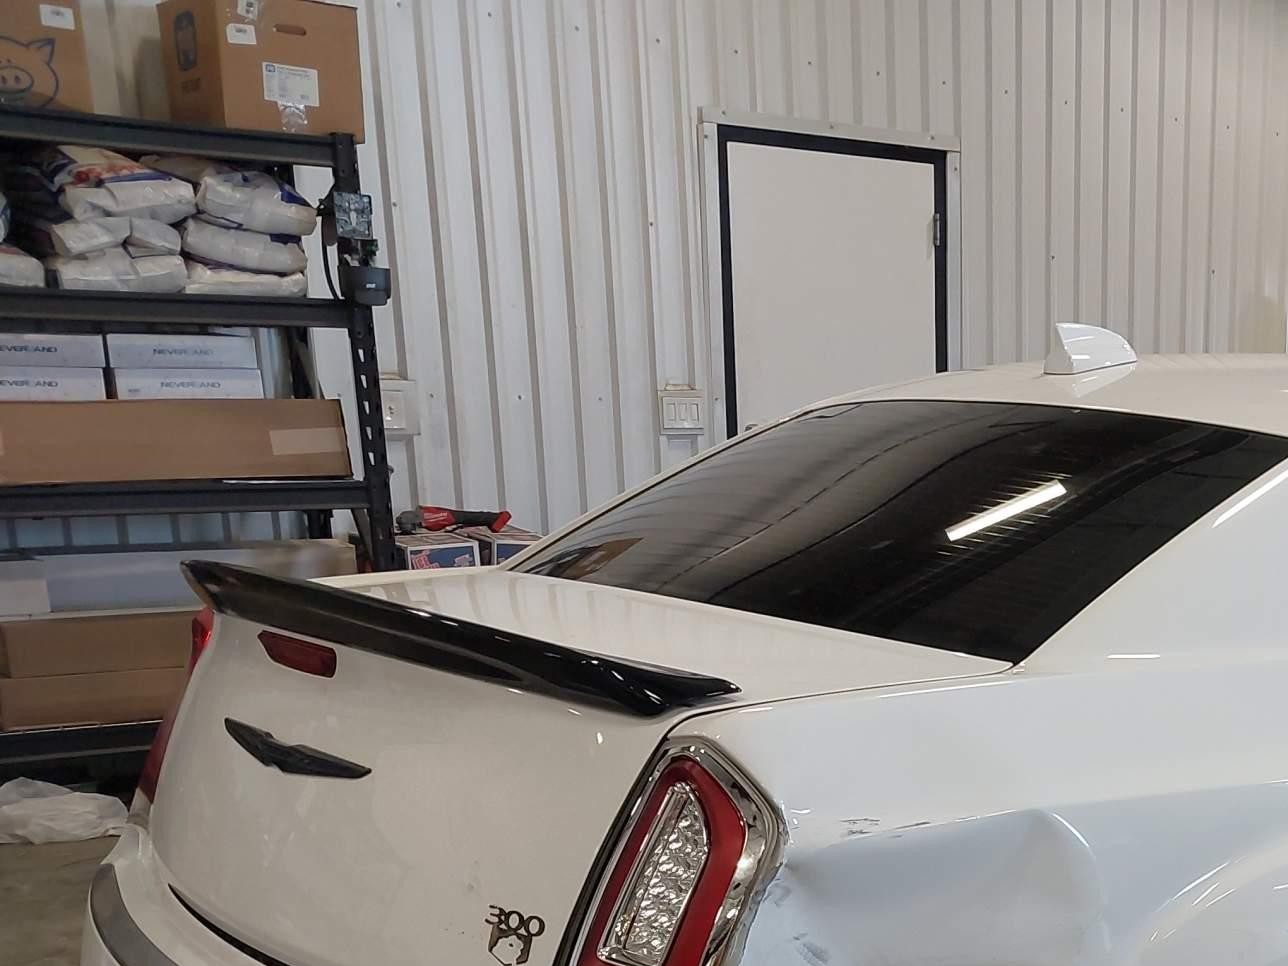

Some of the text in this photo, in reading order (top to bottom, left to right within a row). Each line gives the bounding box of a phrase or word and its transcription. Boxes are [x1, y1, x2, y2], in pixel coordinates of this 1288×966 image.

[152, 348, 215, 356] NEVERAND
[160, 381, 222, 389] NEVERAND
[484, 904, 546, 937] 300
